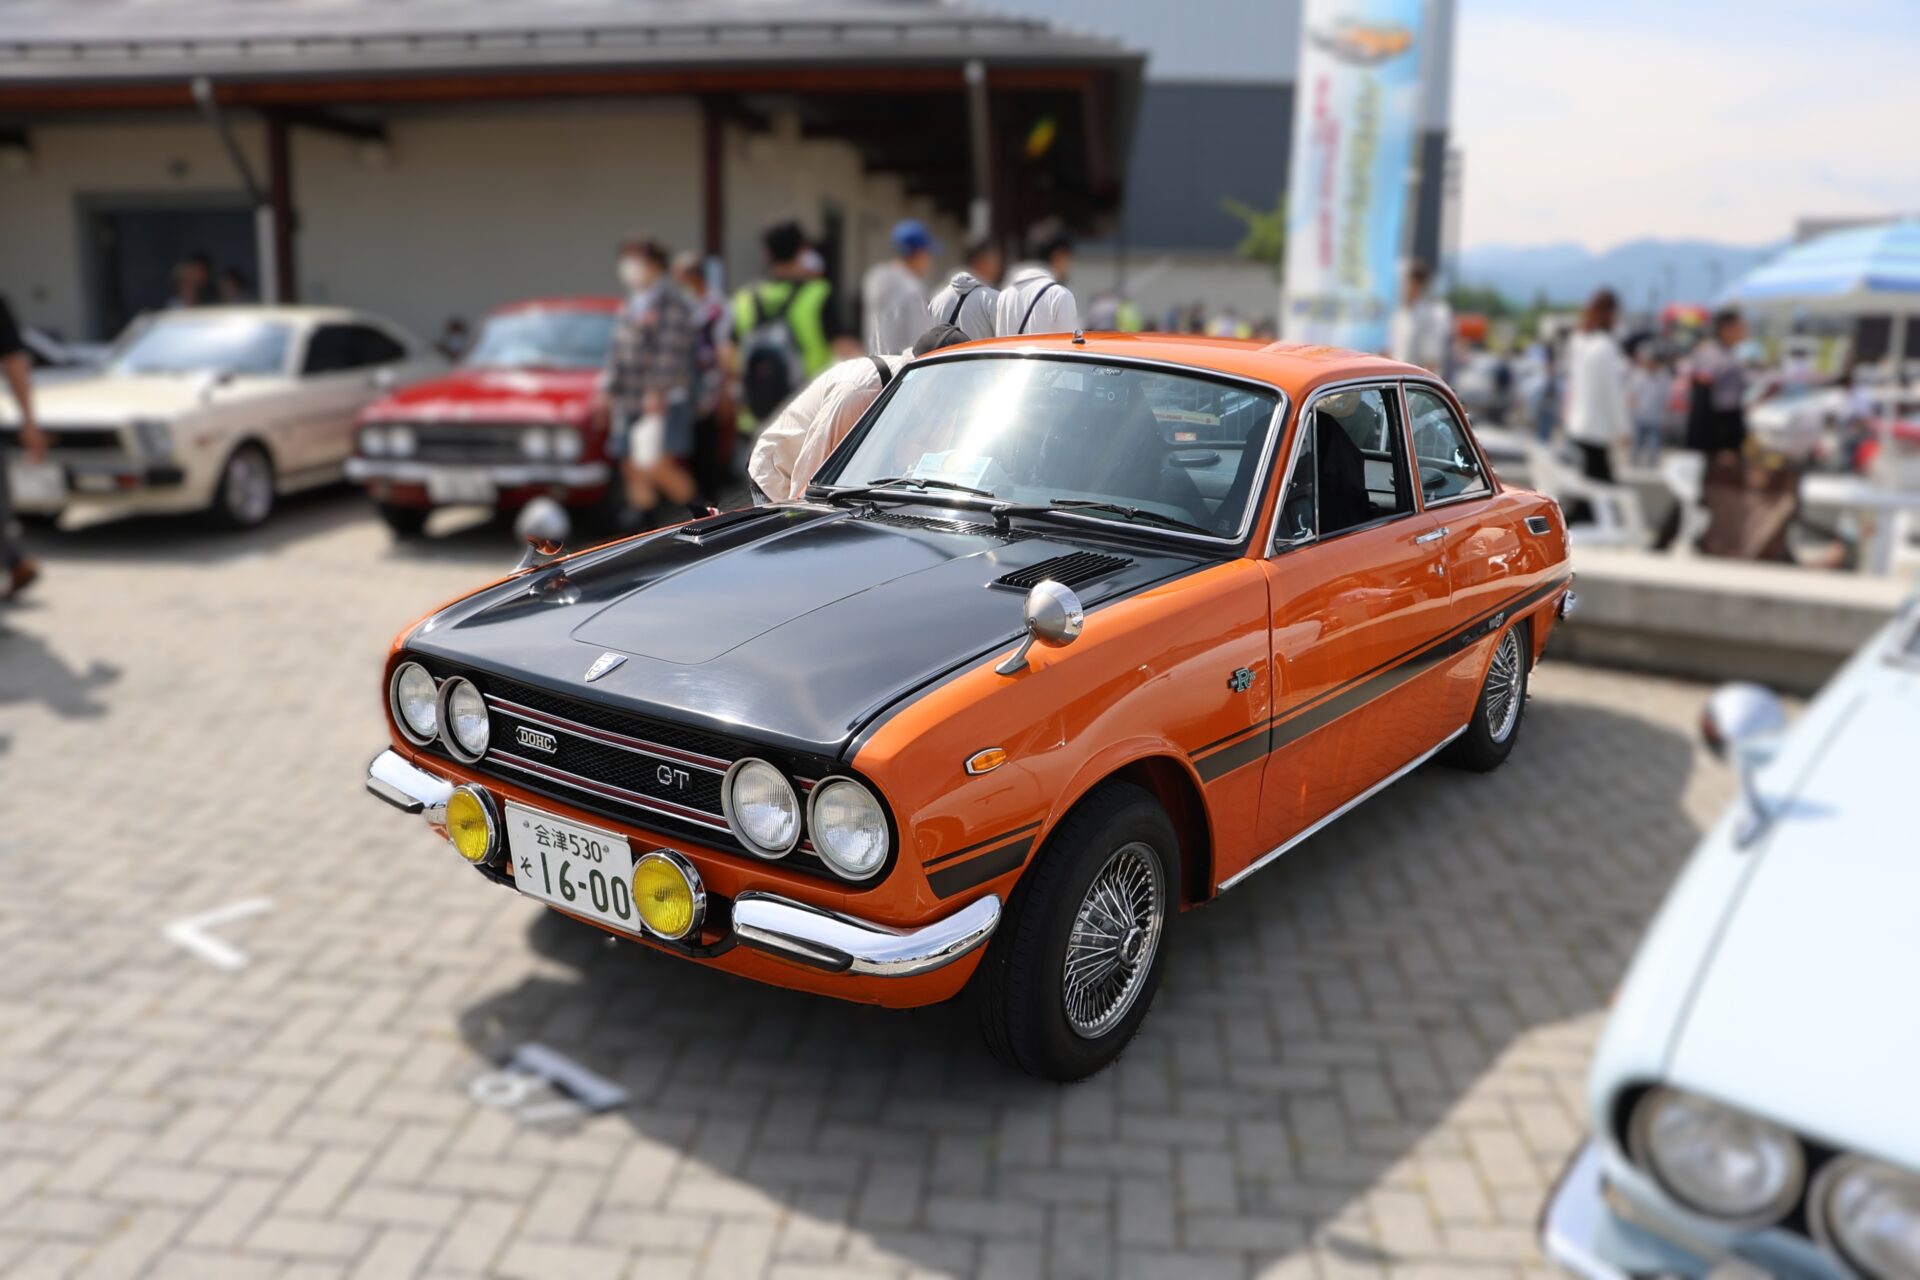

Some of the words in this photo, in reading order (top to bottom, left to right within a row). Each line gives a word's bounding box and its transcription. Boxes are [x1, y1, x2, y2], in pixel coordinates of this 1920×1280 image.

[520, 730, 552, 751] DOHC
[656, 764, 690, 790] GT
[520, 855, 533, 879] そ
[540, 851, 631, 920] 16-00
